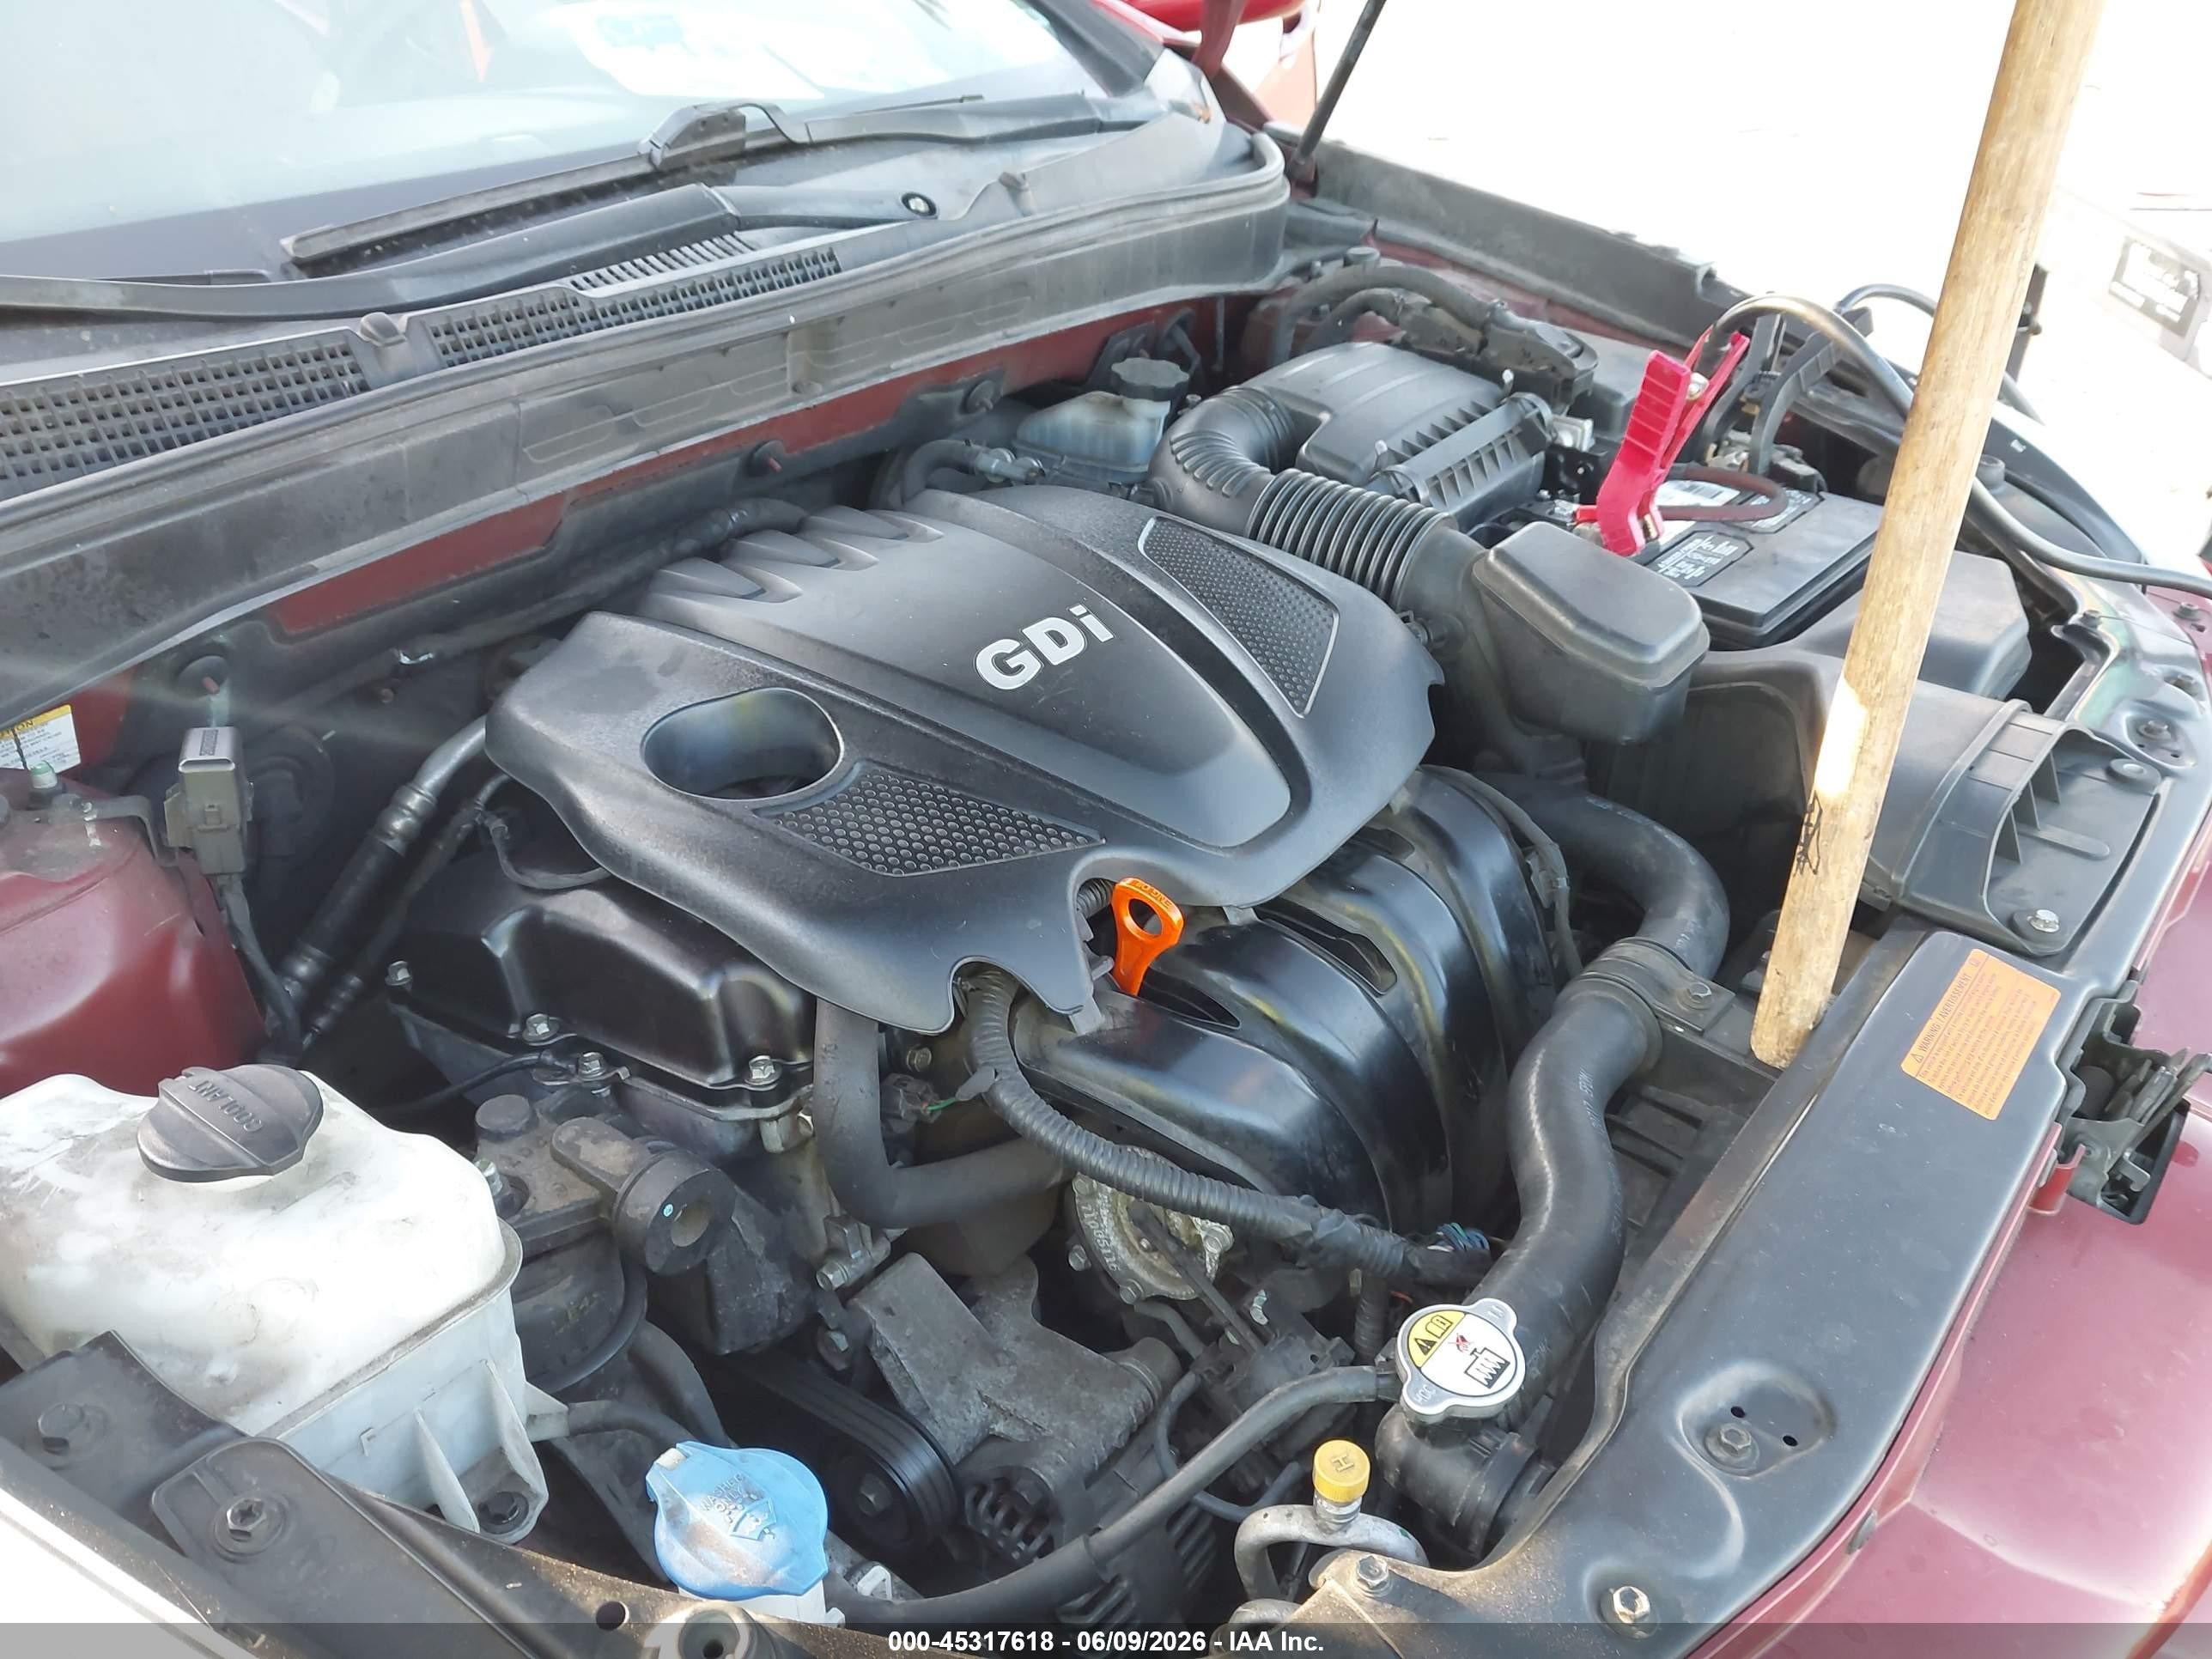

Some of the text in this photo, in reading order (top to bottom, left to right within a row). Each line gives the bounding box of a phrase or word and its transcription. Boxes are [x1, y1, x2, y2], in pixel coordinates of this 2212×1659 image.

[975, 604, 1115, 690] GDi
[1917, 1022, 1941, 1054] WARNING
[1939, 972, 1972, 1021] AVERTISSEMENT
[187, 1080, 263, 1133] COOLANT
[1331, 1454, 1355, 1473] H
